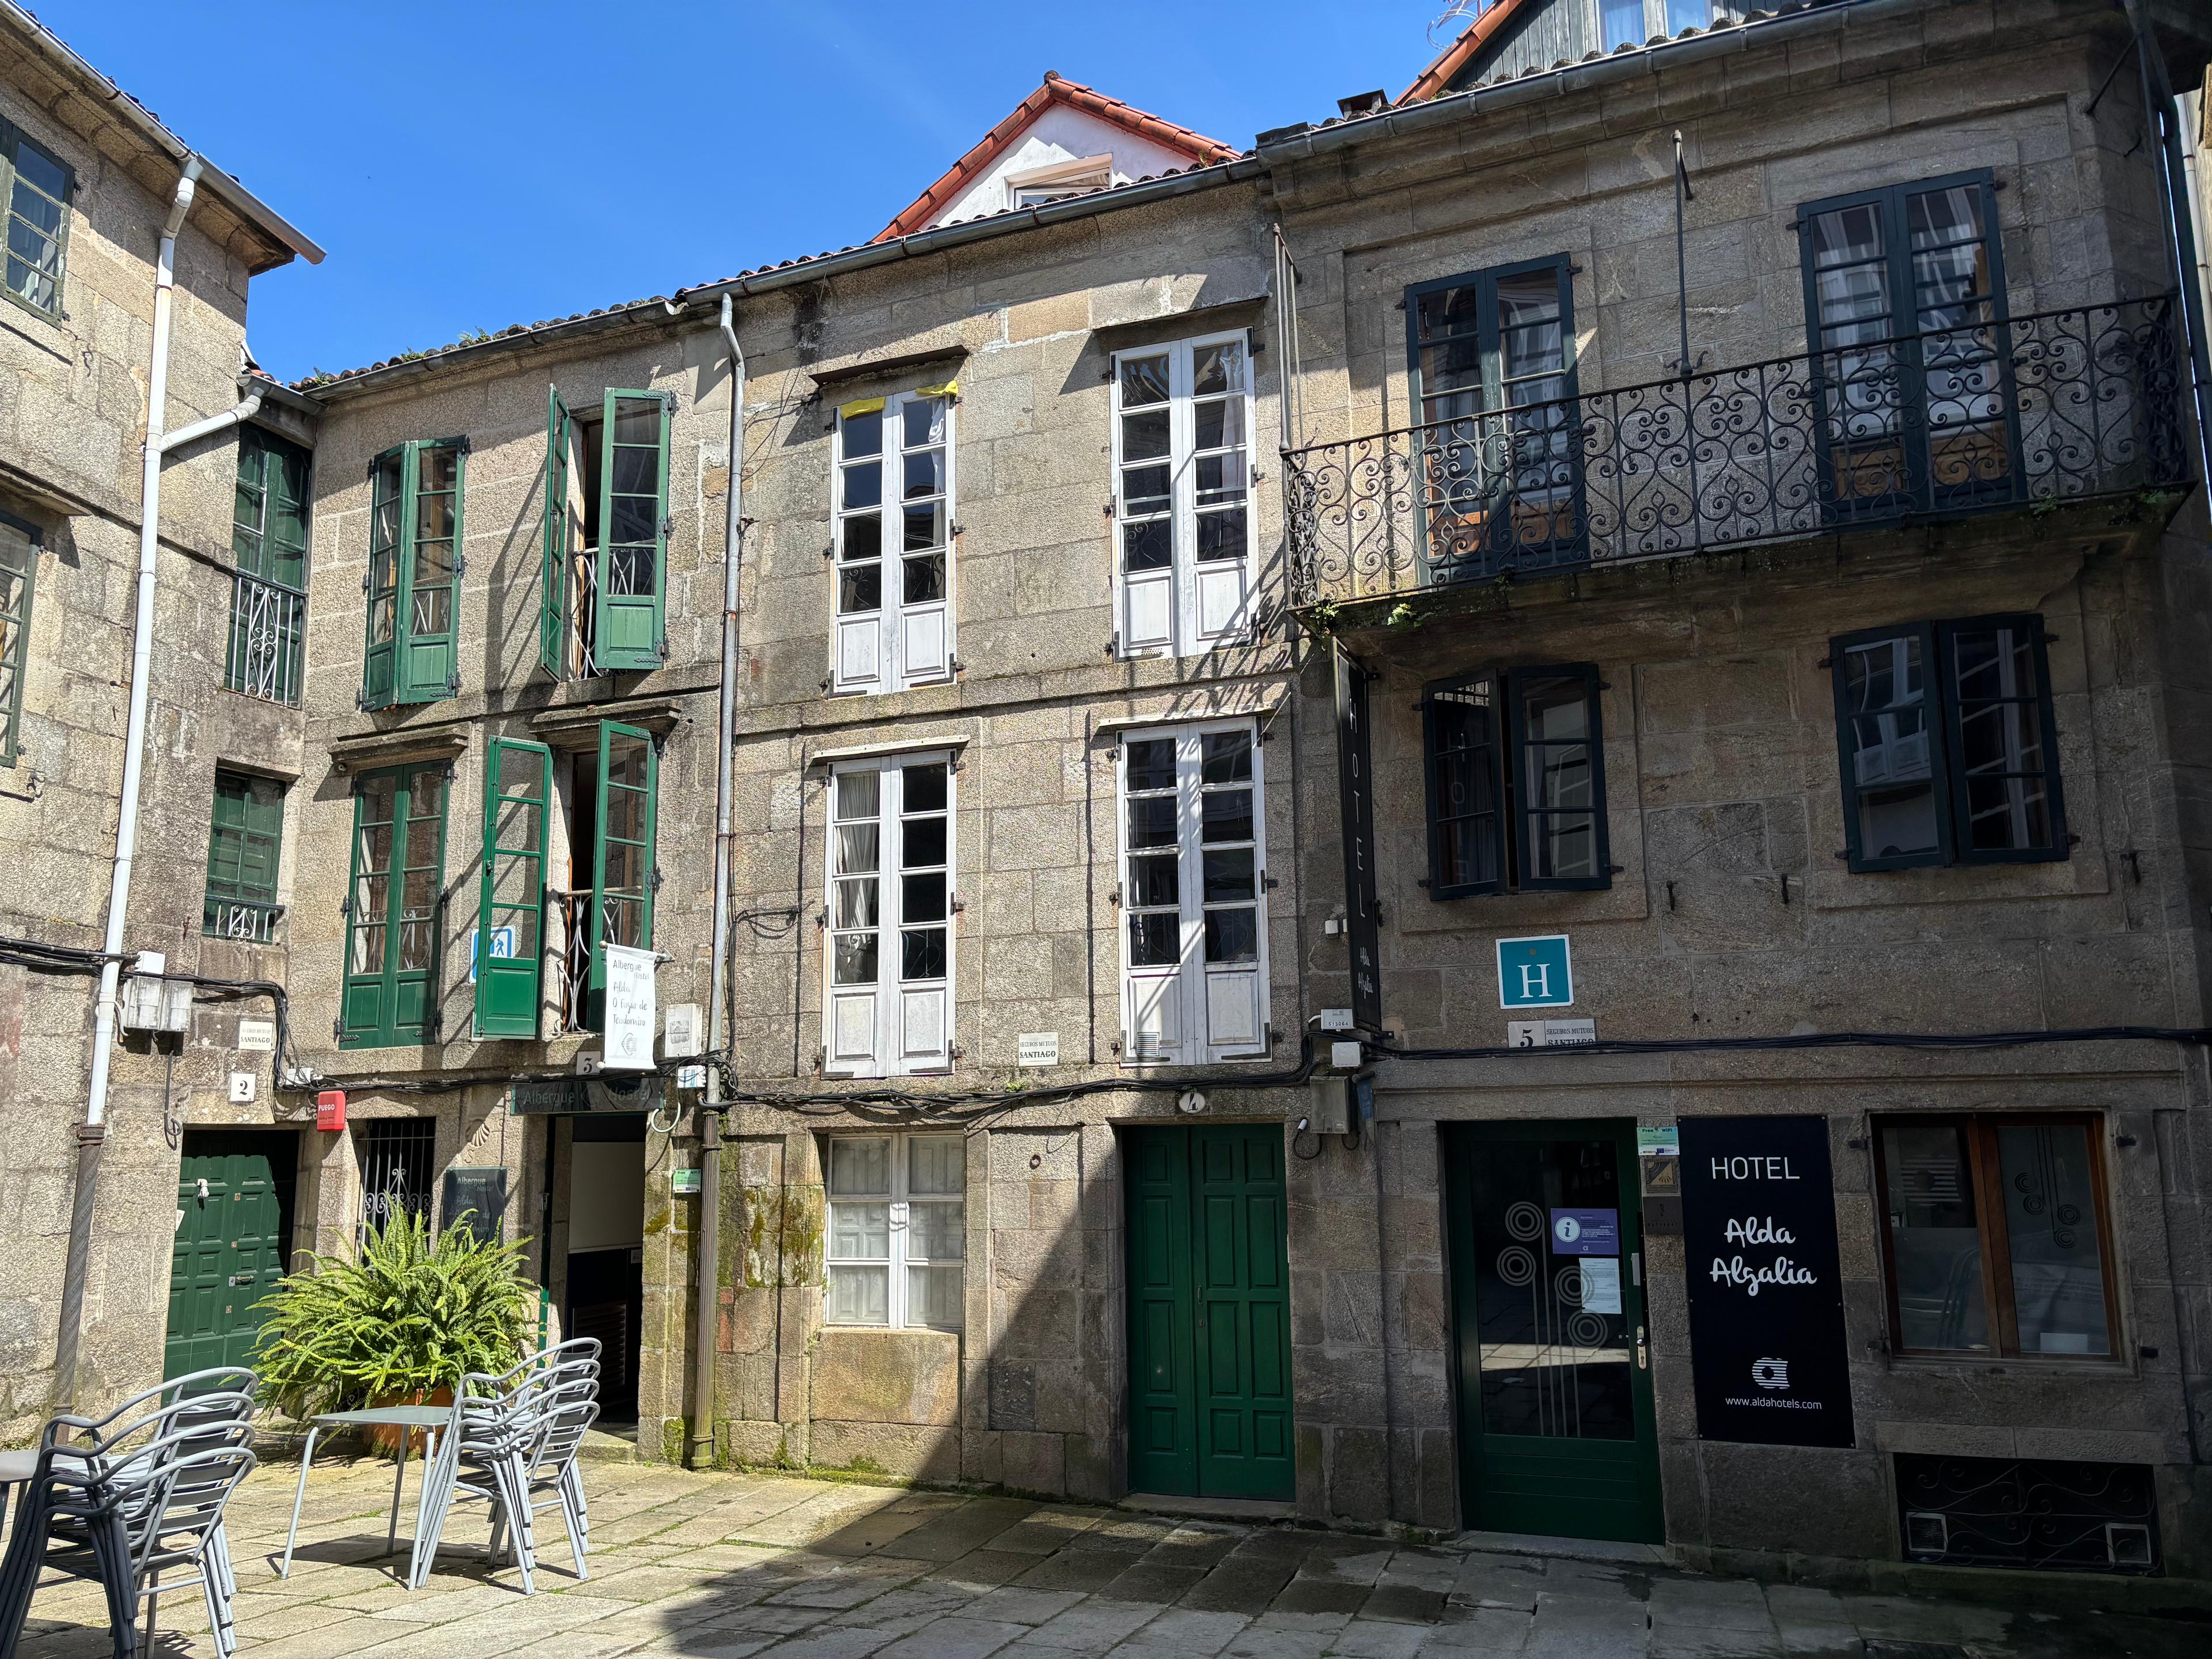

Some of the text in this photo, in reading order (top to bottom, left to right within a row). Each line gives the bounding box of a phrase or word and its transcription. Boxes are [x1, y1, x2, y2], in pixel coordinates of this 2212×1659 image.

[1350, 698, 1365, 918] HOTEL
[613, 959, 641, 972] Albergue
[634, 971, 649, 980] Hostel
[1517, 963, 1552, 998] H
[613, 981, 631, 993] Alda
[639, 999, 647, 1010] de
[613, 1014, 646, 1026] Teodomiro
[1520, 1029, 1533, 1047] 5
[584, 1057, 593, 1074] 3
[239, 1080, 248, 1096] 2
[522, 1090, 574, 1107] Albergue
[1187, 1093, 1199, 1112] 4
[1711, 1157, 1800, 1179] HOTEL
[457, 1177, 486, 1186] Albergue
[1724, 1216, 1796, 1248] Alda
[1709, 1255, 1817, 1296] Algalia
[1725, 1397, 1822, 1410] www.aldahotels.com
